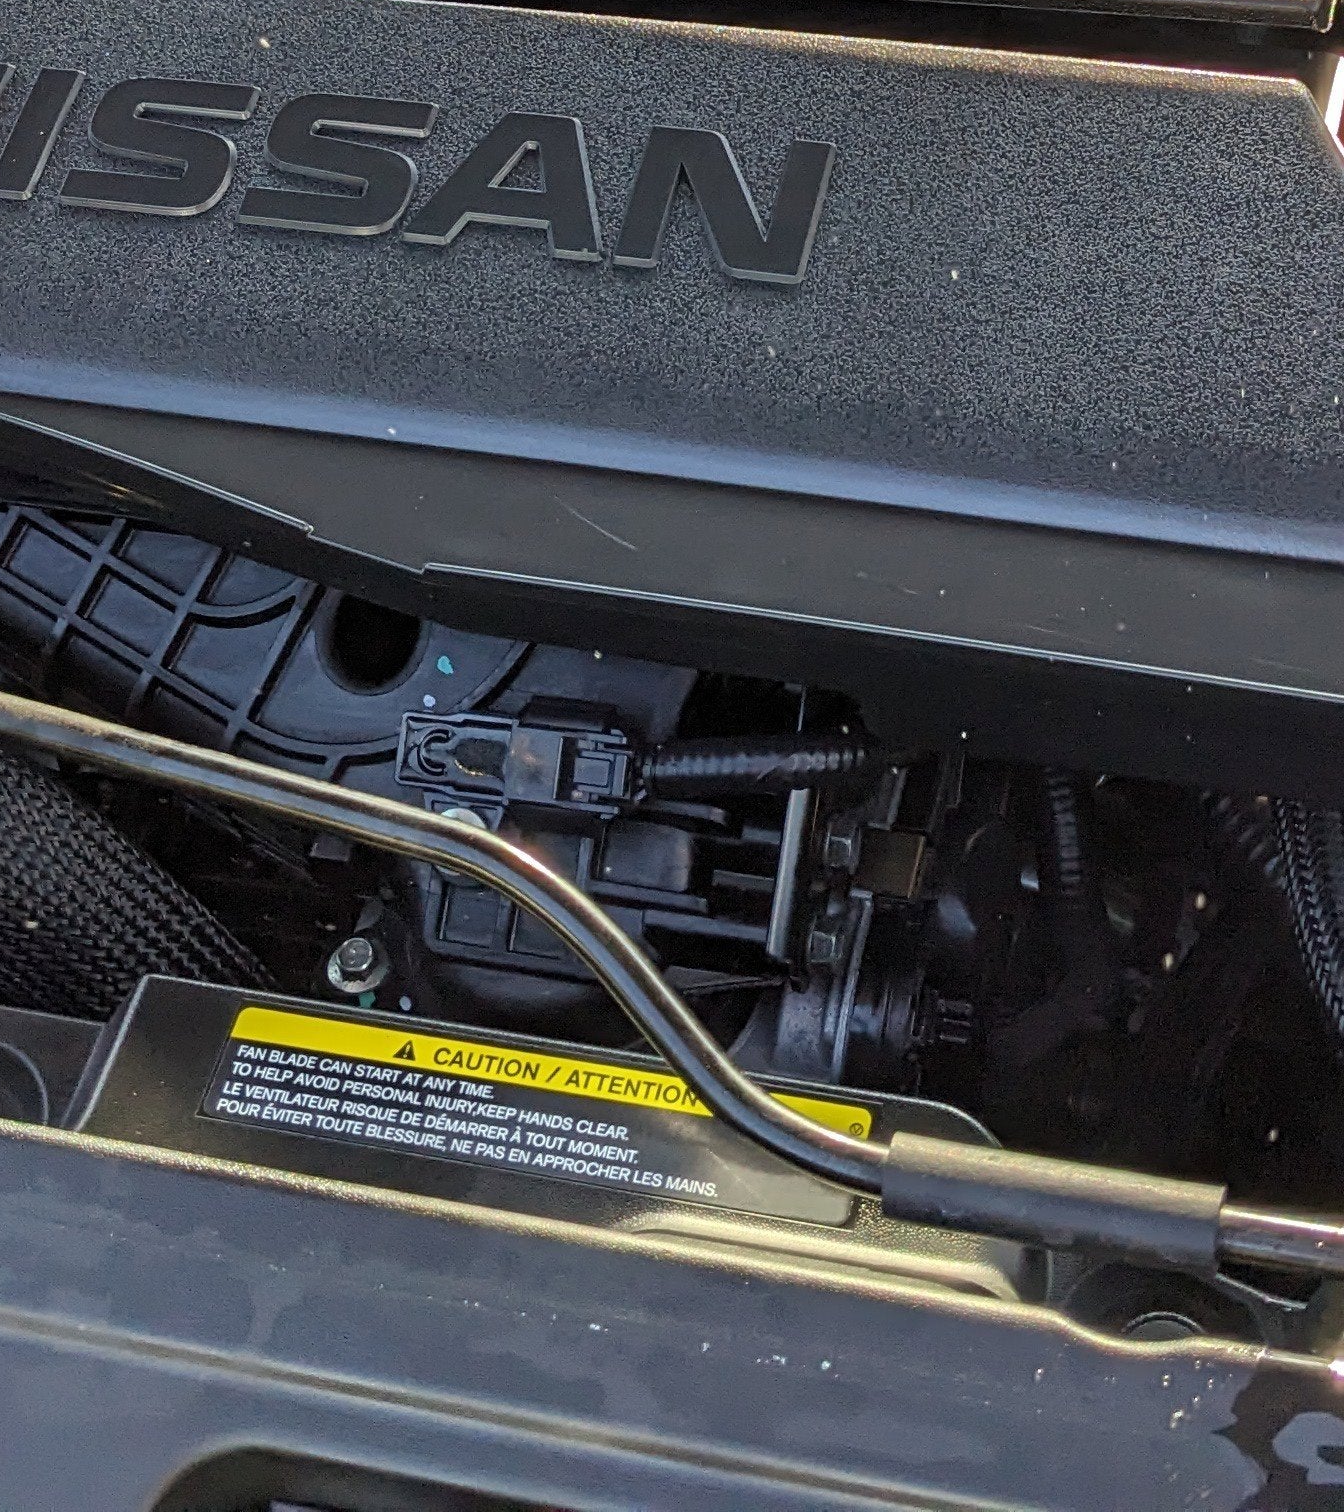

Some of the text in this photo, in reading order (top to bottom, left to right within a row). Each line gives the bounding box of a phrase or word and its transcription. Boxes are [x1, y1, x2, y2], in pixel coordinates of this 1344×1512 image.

[231, 1060, 256, 1078] TO
[254, 1065, 294, 1084] HELP
[293, 1072, 340, 1091] AVOID
[341, 1079, 423, 1106] PERSONAL
[518, 1110, 574, 1132] HANDS
[575, 1119, 630, 1141] CLEAR.
[236, 1044, 495, 1100] FAN BLADE CAN START AT ANY TIME.
[432, 1046, 700, 1107] CAUTION / ATTENTION
[215, 1097, 720, 1199] POUR ÉVITER TOUTE BLESSURE, NE PAS EN APPROCHER LES MAINS.
[221, 1080, 640, 1165] LE VENTILATEUR RISQUE DE DÉMARRER À TOUT MOMENT.
